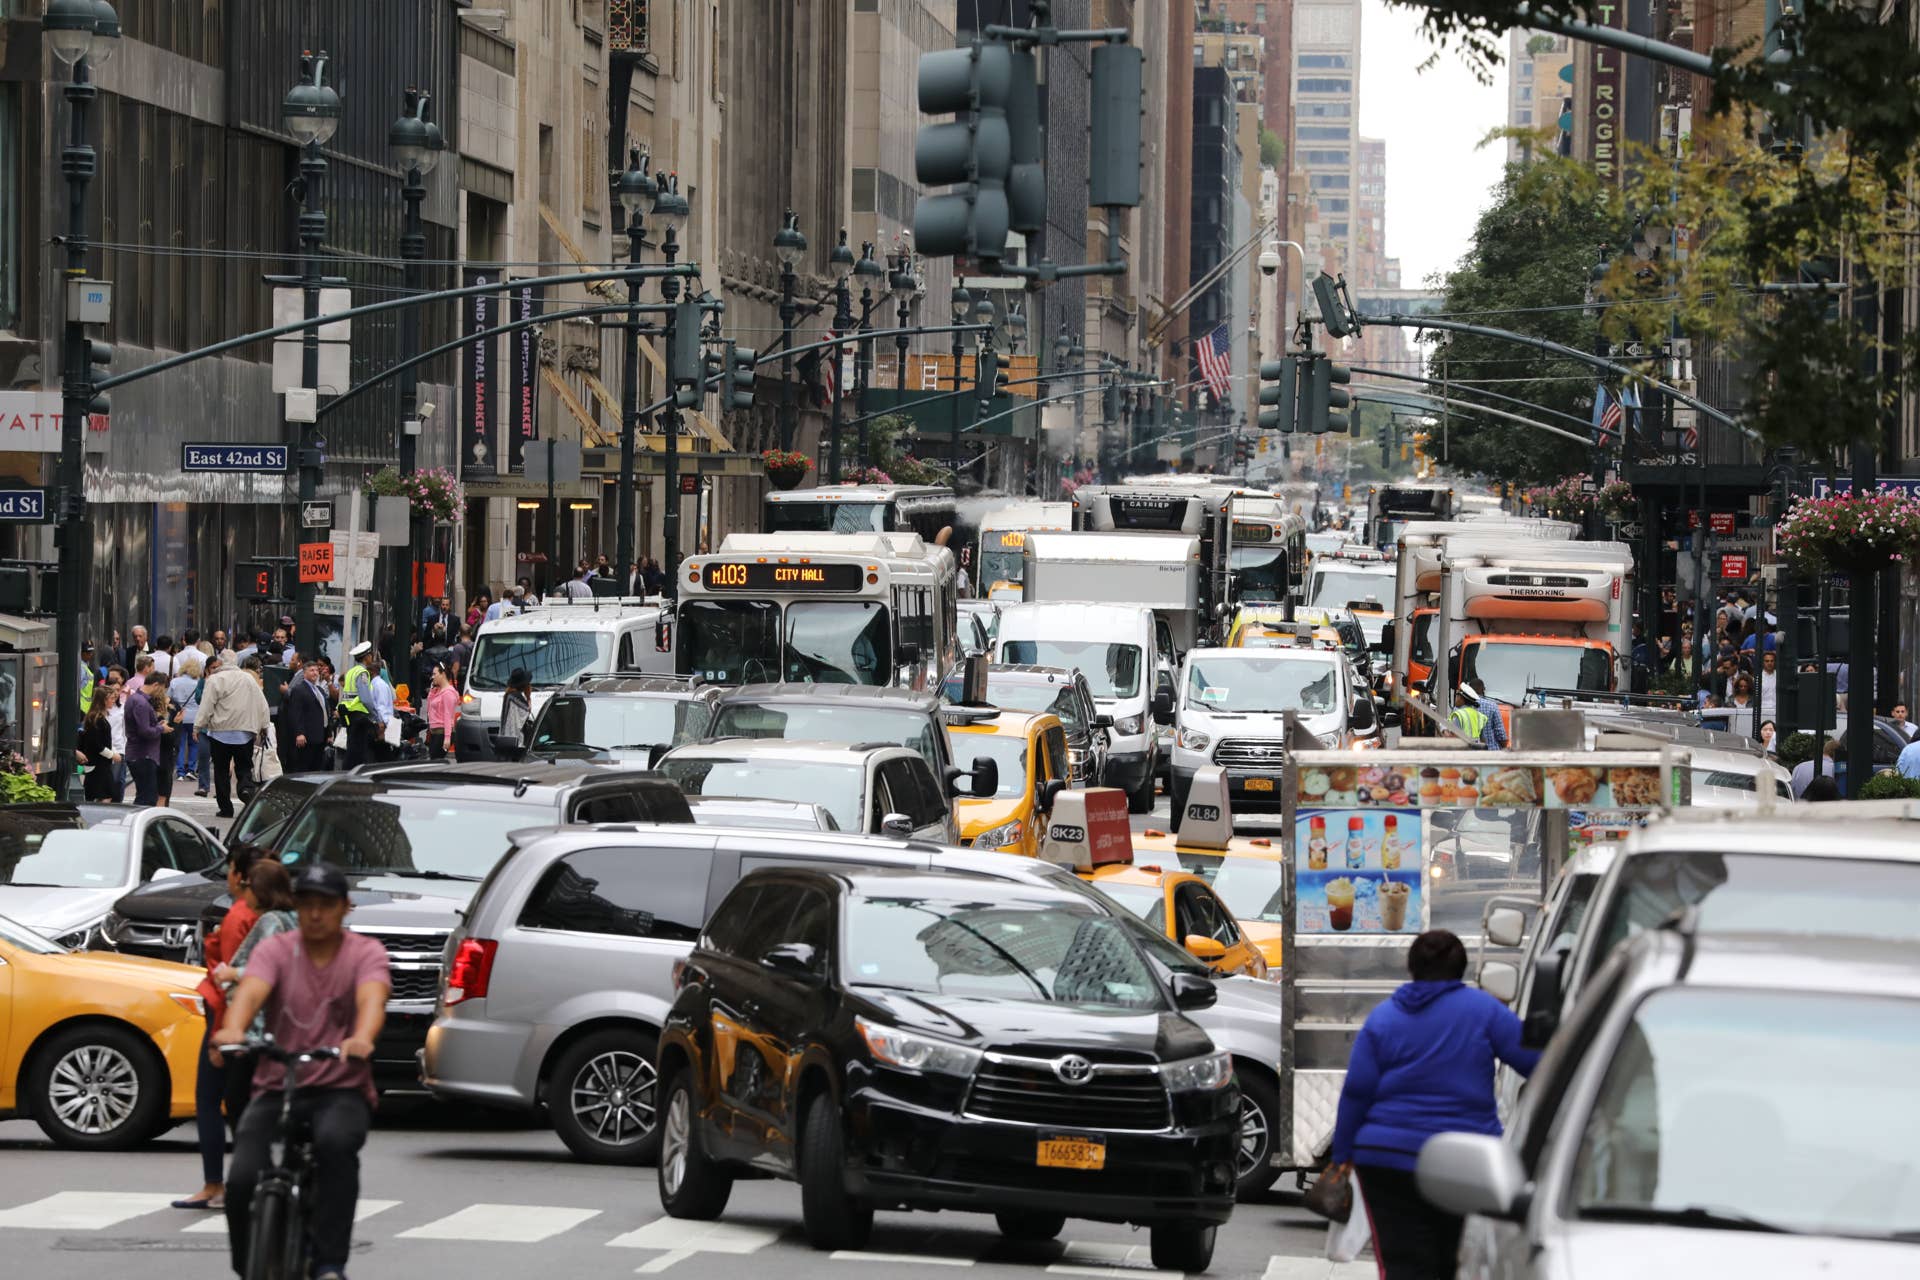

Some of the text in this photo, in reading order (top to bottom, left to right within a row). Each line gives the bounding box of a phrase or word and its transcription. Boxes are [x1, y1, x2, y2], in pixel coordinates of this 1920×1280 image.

[475, 276, 486, 434] GAND CNTRAL MARKET
[521, 386, 532, 437] MARKET
[189, 450, 282, 465] East 42nd St
[20, 496, 38, 513] St
[1736, 532, 1764, 541] BANK
[302, 549, 330, 561] RAISE
[302, 563, 330, 576] PLOW
[712, 564, 825, 585] M103 CITY HALL
[1509, 588, 1565, 597] THERMO KING
[1189, 806, 1218, 821] 2L84
[1051, 826, 1085, 841] 8K23
